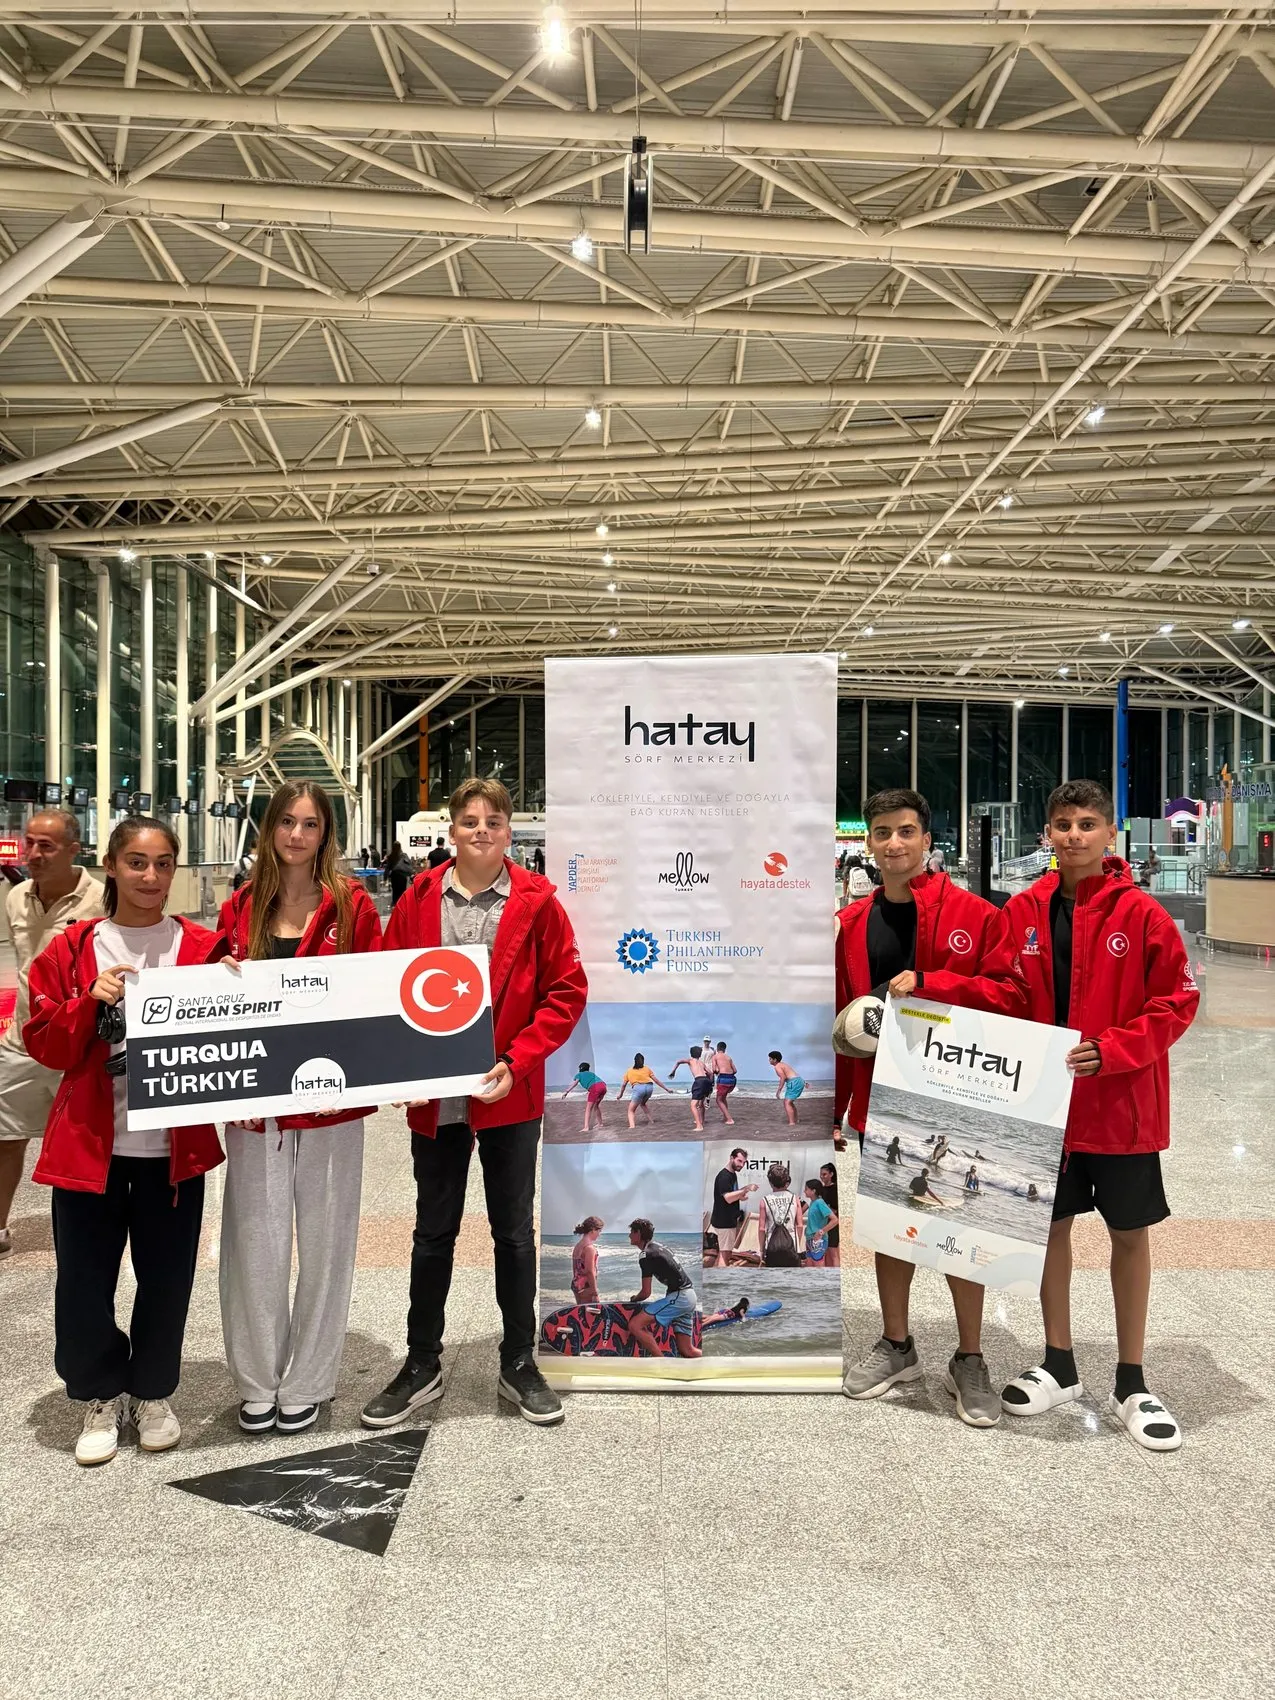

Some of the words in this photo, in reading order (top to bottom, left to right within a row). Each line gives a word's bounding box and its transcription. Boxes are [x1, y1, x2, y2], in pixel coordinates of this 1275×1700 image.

[625, 706, 755, 762] hatay
[625, 754, 662, 763] SÖRF
[674, 753, 743, 763] MERKEZİ
[736, 793, 790, 802] DOĞAYLA
[630, 807, 653, 816] BAĞ
[569, 860, 577, 892] YAPDER
[667, 930, 721, 942] TURKISH
[667, 945, 764, 957] PHILANTHROPY
[667, 960, 709, 972] FUNDS
[282, 974, 328, 992] hatay
[178, 997, 213, 1008] SANTA
[216, 994, 245, 1004] CRUZ
[176, 1006, 229, 1020] OCEAN
[232, 1001, 283, 1015] SPIRIT
[142, 1040, 268, 1068] TURQUIA
[924, 1027, 1022, 1092] hatay
[143, 1069, 258, 1097] TÜRKIYE
[295, 1075, 342, 1093] hatay
[922, 1065, 950, 1076] SÖRF
[957, 1073, 1009, 1090] MERKEZİ
